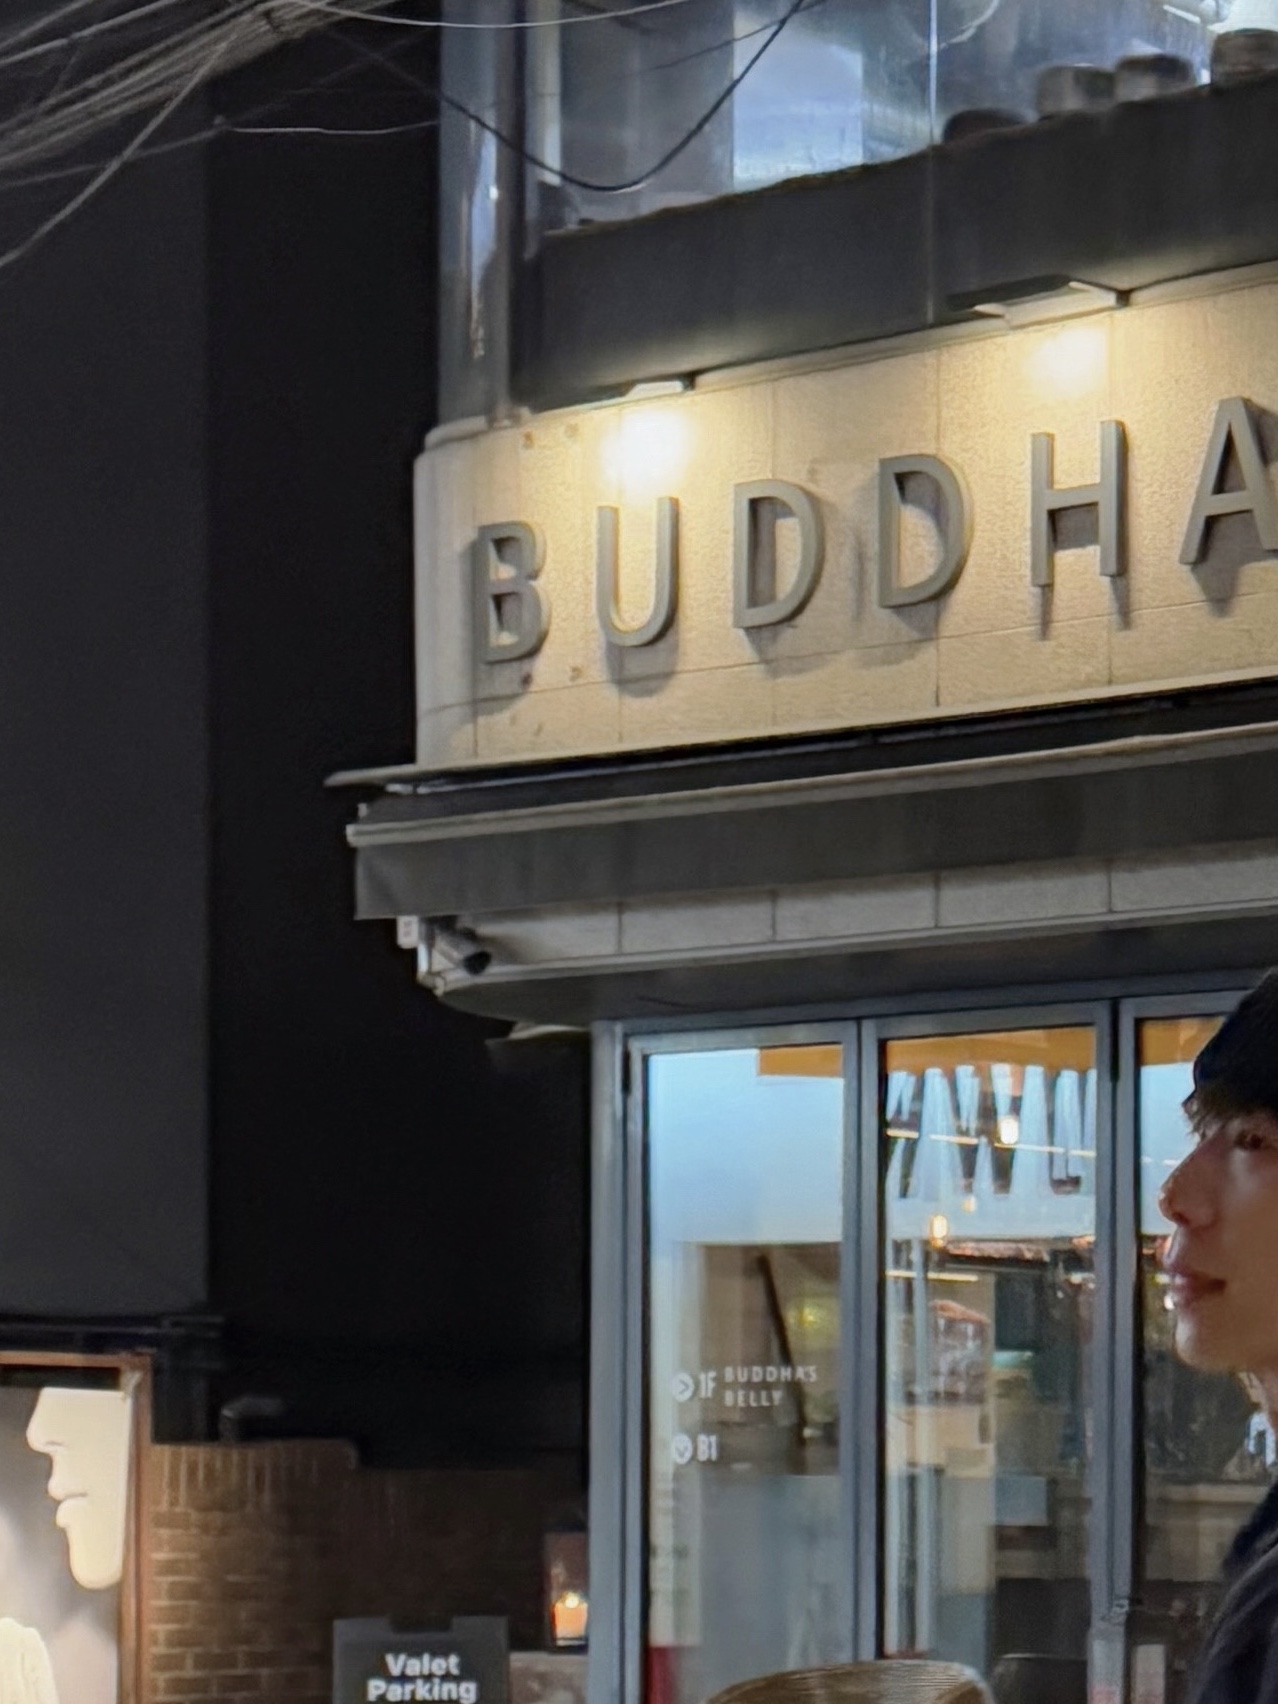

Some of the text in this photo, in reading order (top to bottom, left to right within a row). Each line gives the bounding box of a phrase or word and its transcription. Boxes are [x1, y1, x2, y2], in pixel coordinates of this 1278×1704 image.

[699, 1370, 718, 1399] 1F
[724, 1390, 784, 1407] BELLY
[697, 1433, 718, 1462] B1
[384, 1652, 461, 1677] Valet
